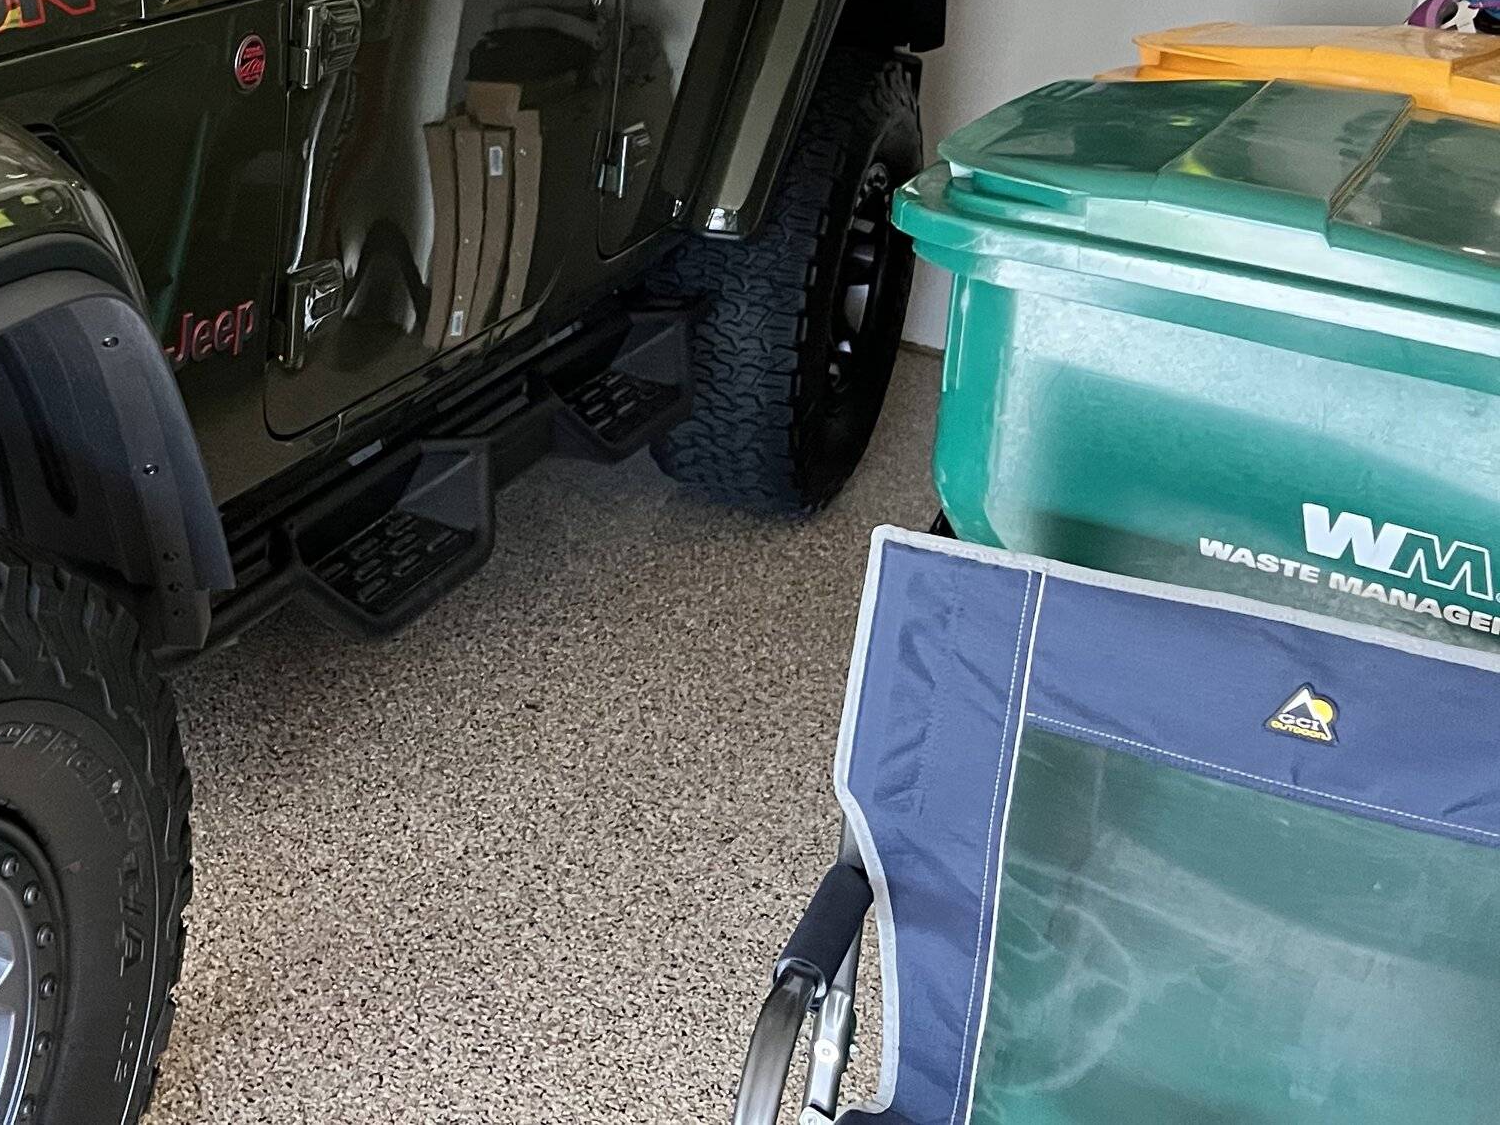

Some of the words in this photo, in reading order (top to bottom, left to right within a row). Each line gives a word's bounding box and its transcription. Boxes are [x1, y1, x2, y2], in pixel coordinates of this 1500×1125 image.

[163, 300, 255, 364] Jeep
[1199, 537, 1321, 584] WASTE
[1302, 502, 1494, 601] WM
[1277, 713, 1322, 731] GCI
